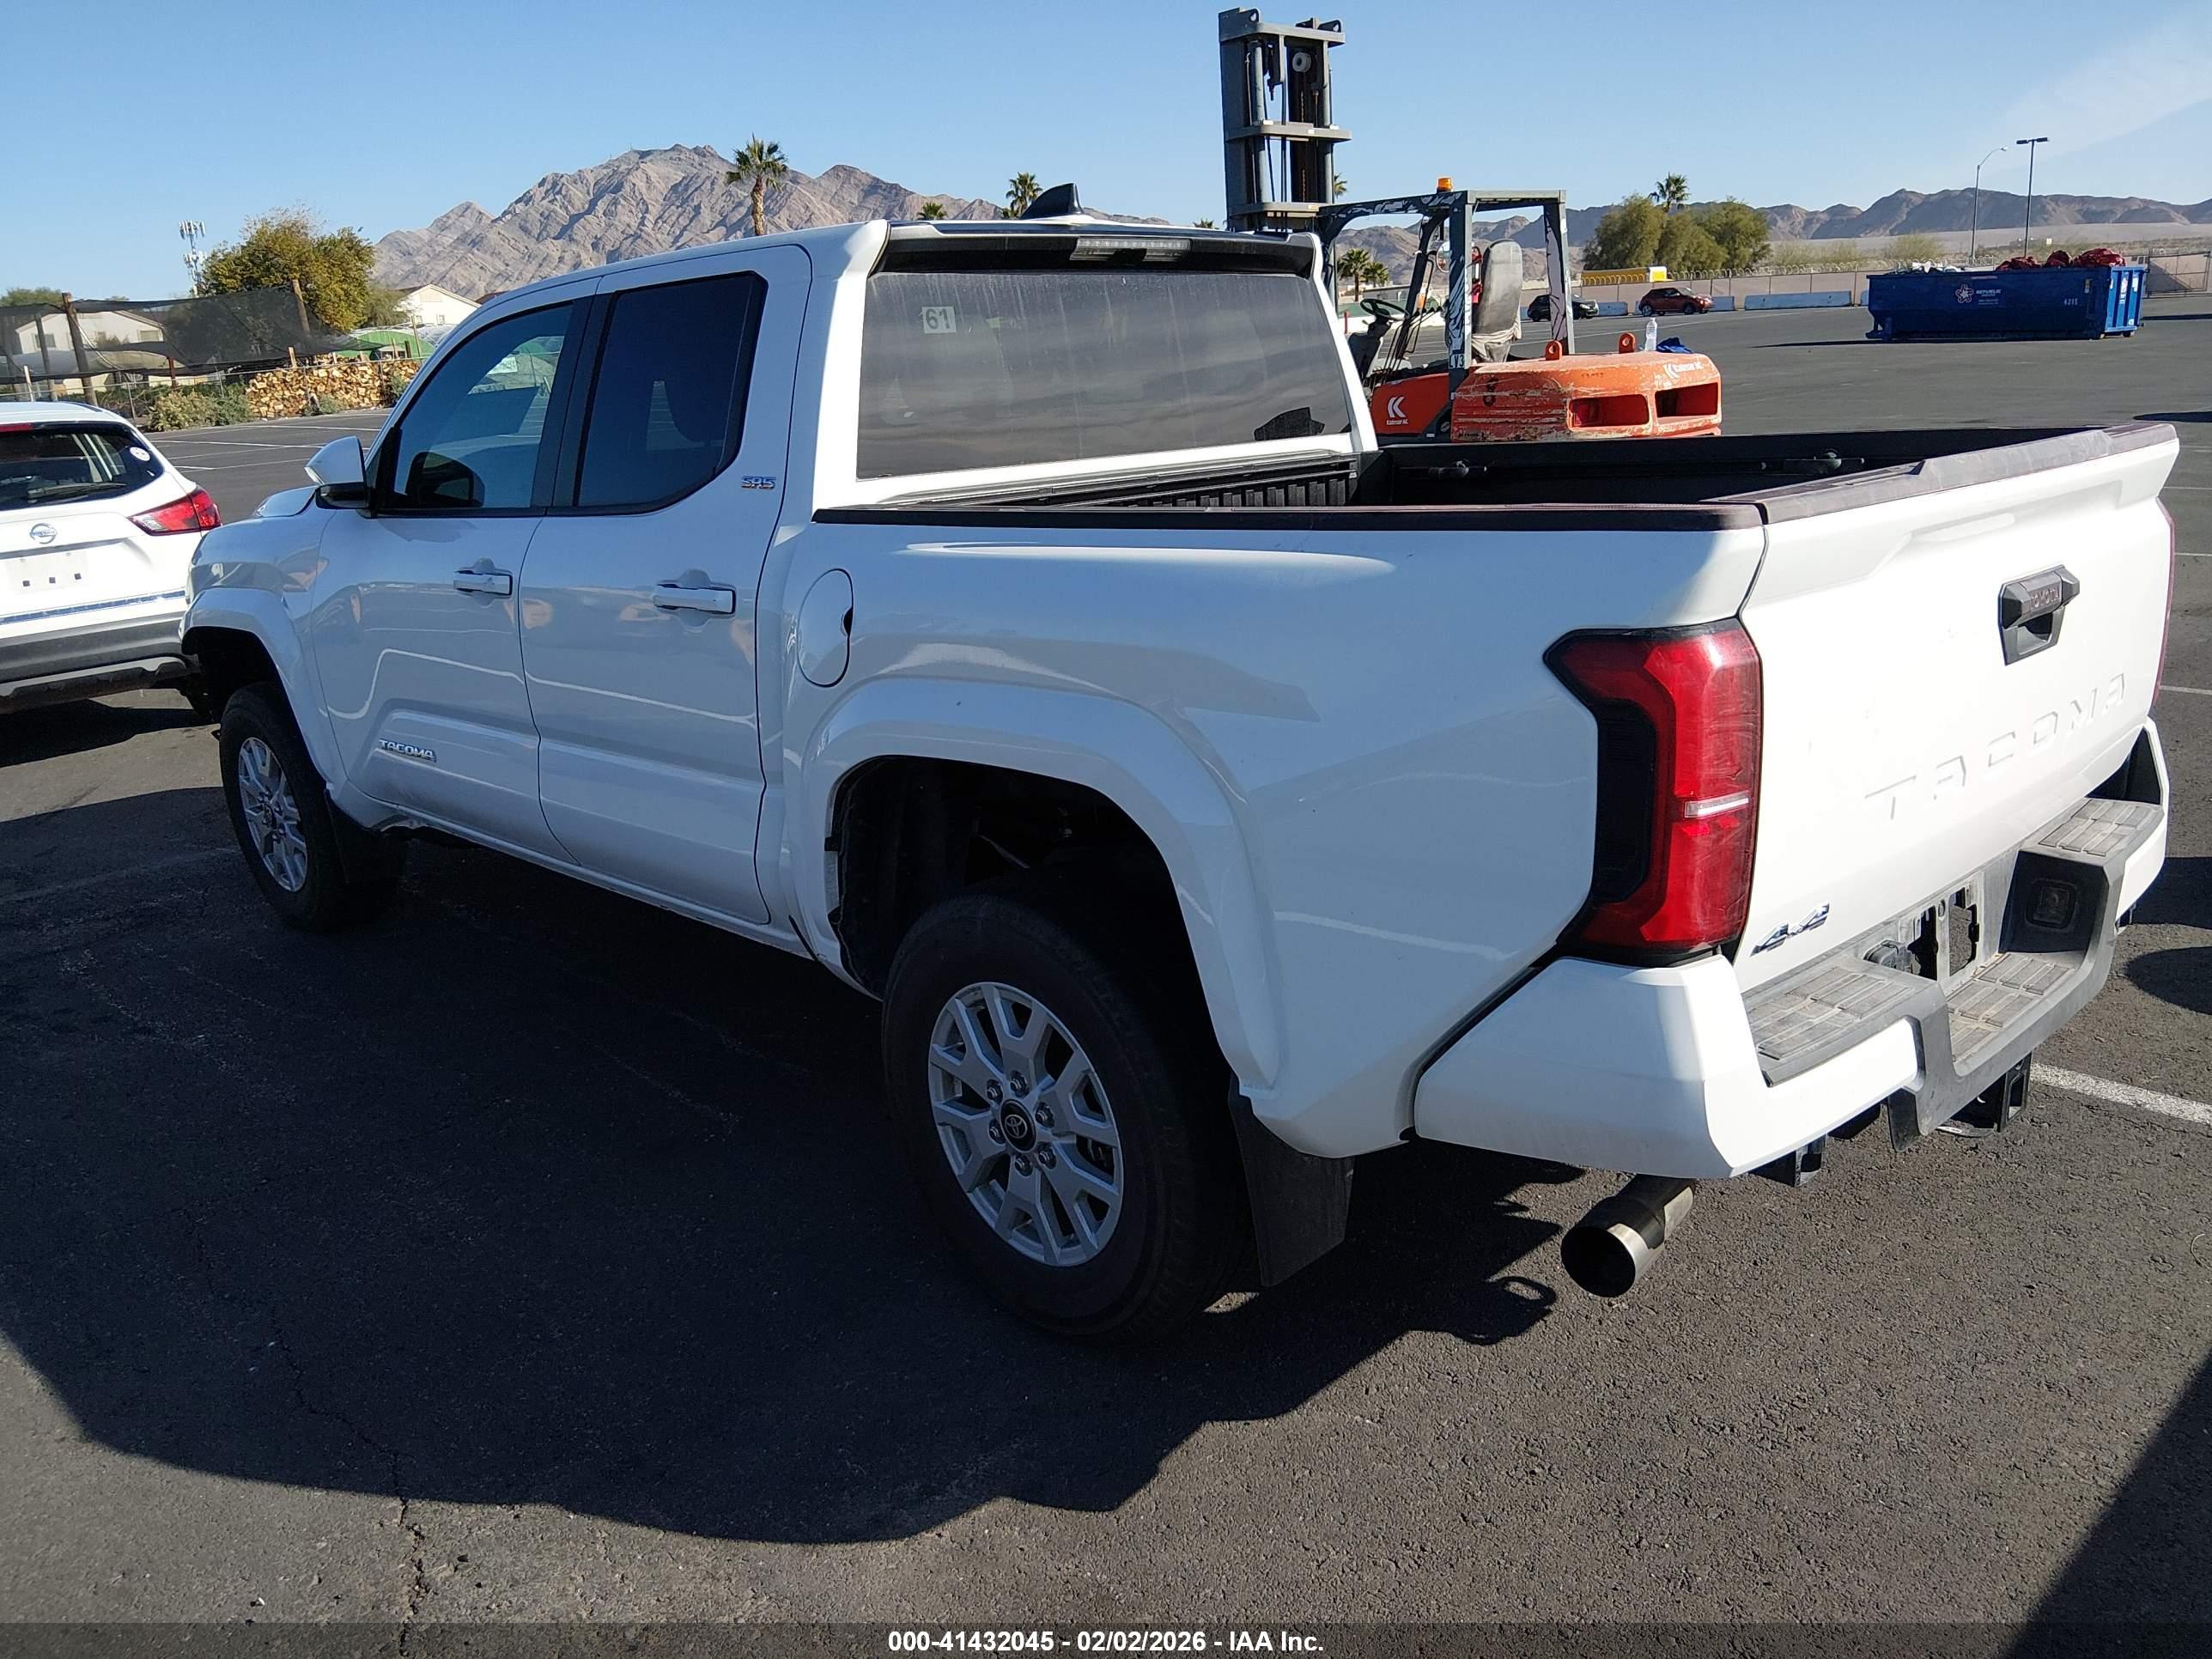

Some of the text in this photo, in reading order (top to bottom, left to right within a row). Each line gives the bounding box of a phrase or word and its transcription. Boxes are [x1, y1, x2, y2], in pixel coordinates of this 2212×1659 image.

[926, 308, 950, 330] 61
[741, 476, 776, 490] SR5
[378, 738, 436, 763] TACOMA
[1863, 672, 2125, 822] TACOMA
